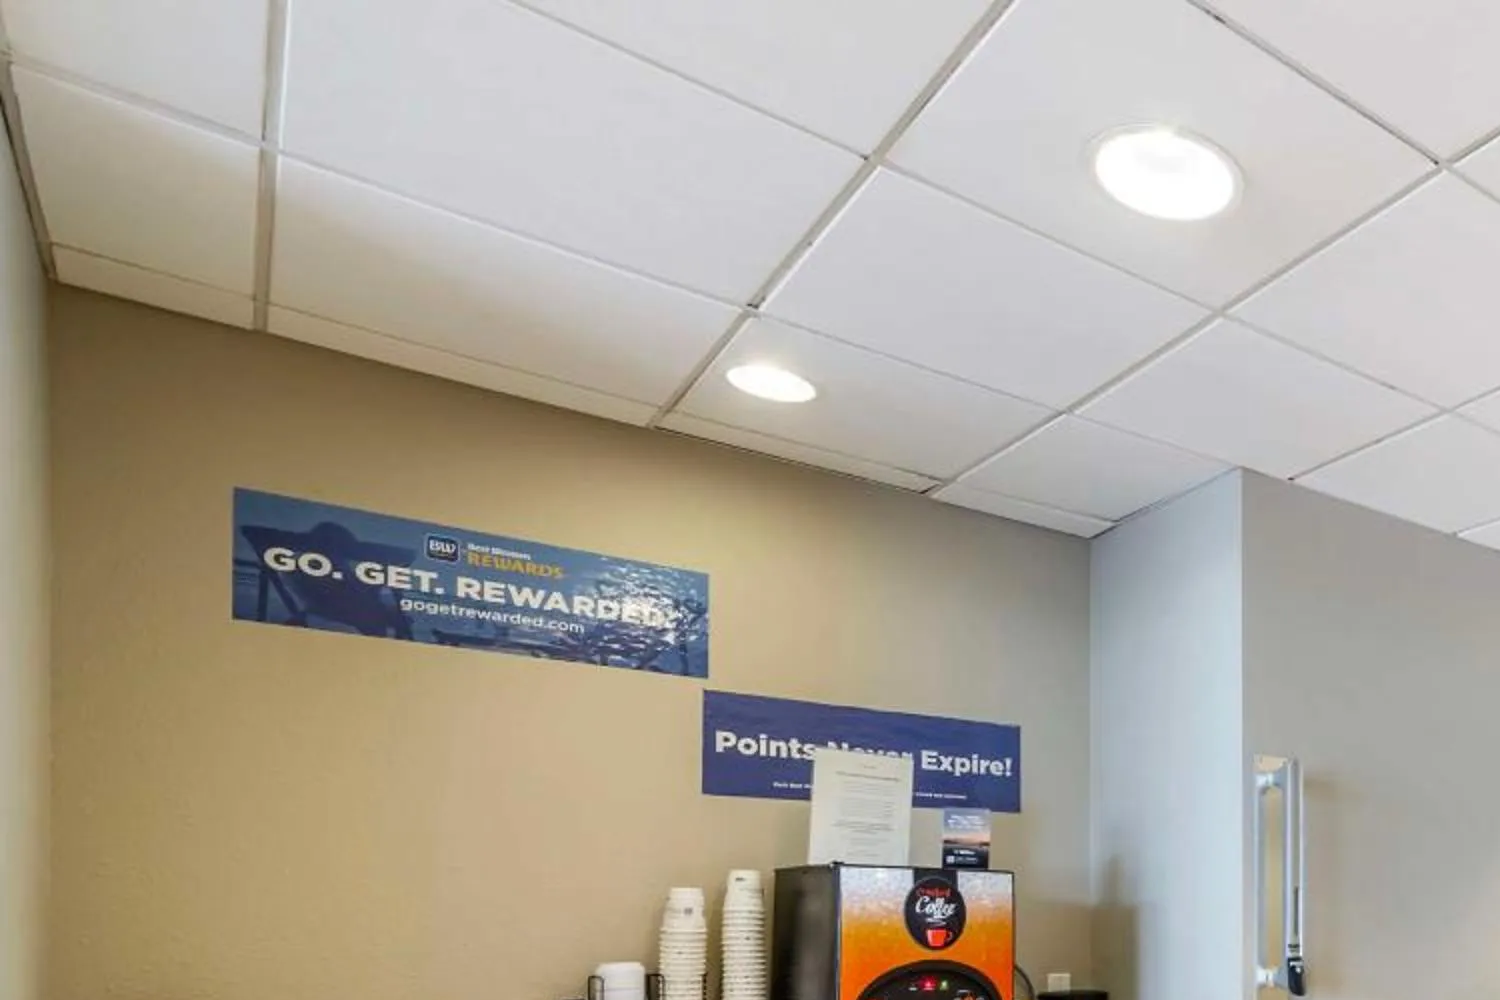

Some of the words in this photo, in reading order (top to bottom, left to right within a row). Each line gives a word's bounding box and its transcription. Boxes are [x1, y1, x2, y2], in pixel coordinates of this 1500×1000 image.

[263, 547, 343, 579] GO.
[355, 562, 445, 596] GET.
[467, 552, 563, 577] REWARDS
[400, 599, 586, 635] gogetrewarded.com
[714, 729, 816, 761] Points
[920, 750, 1013, 777] Expire!
